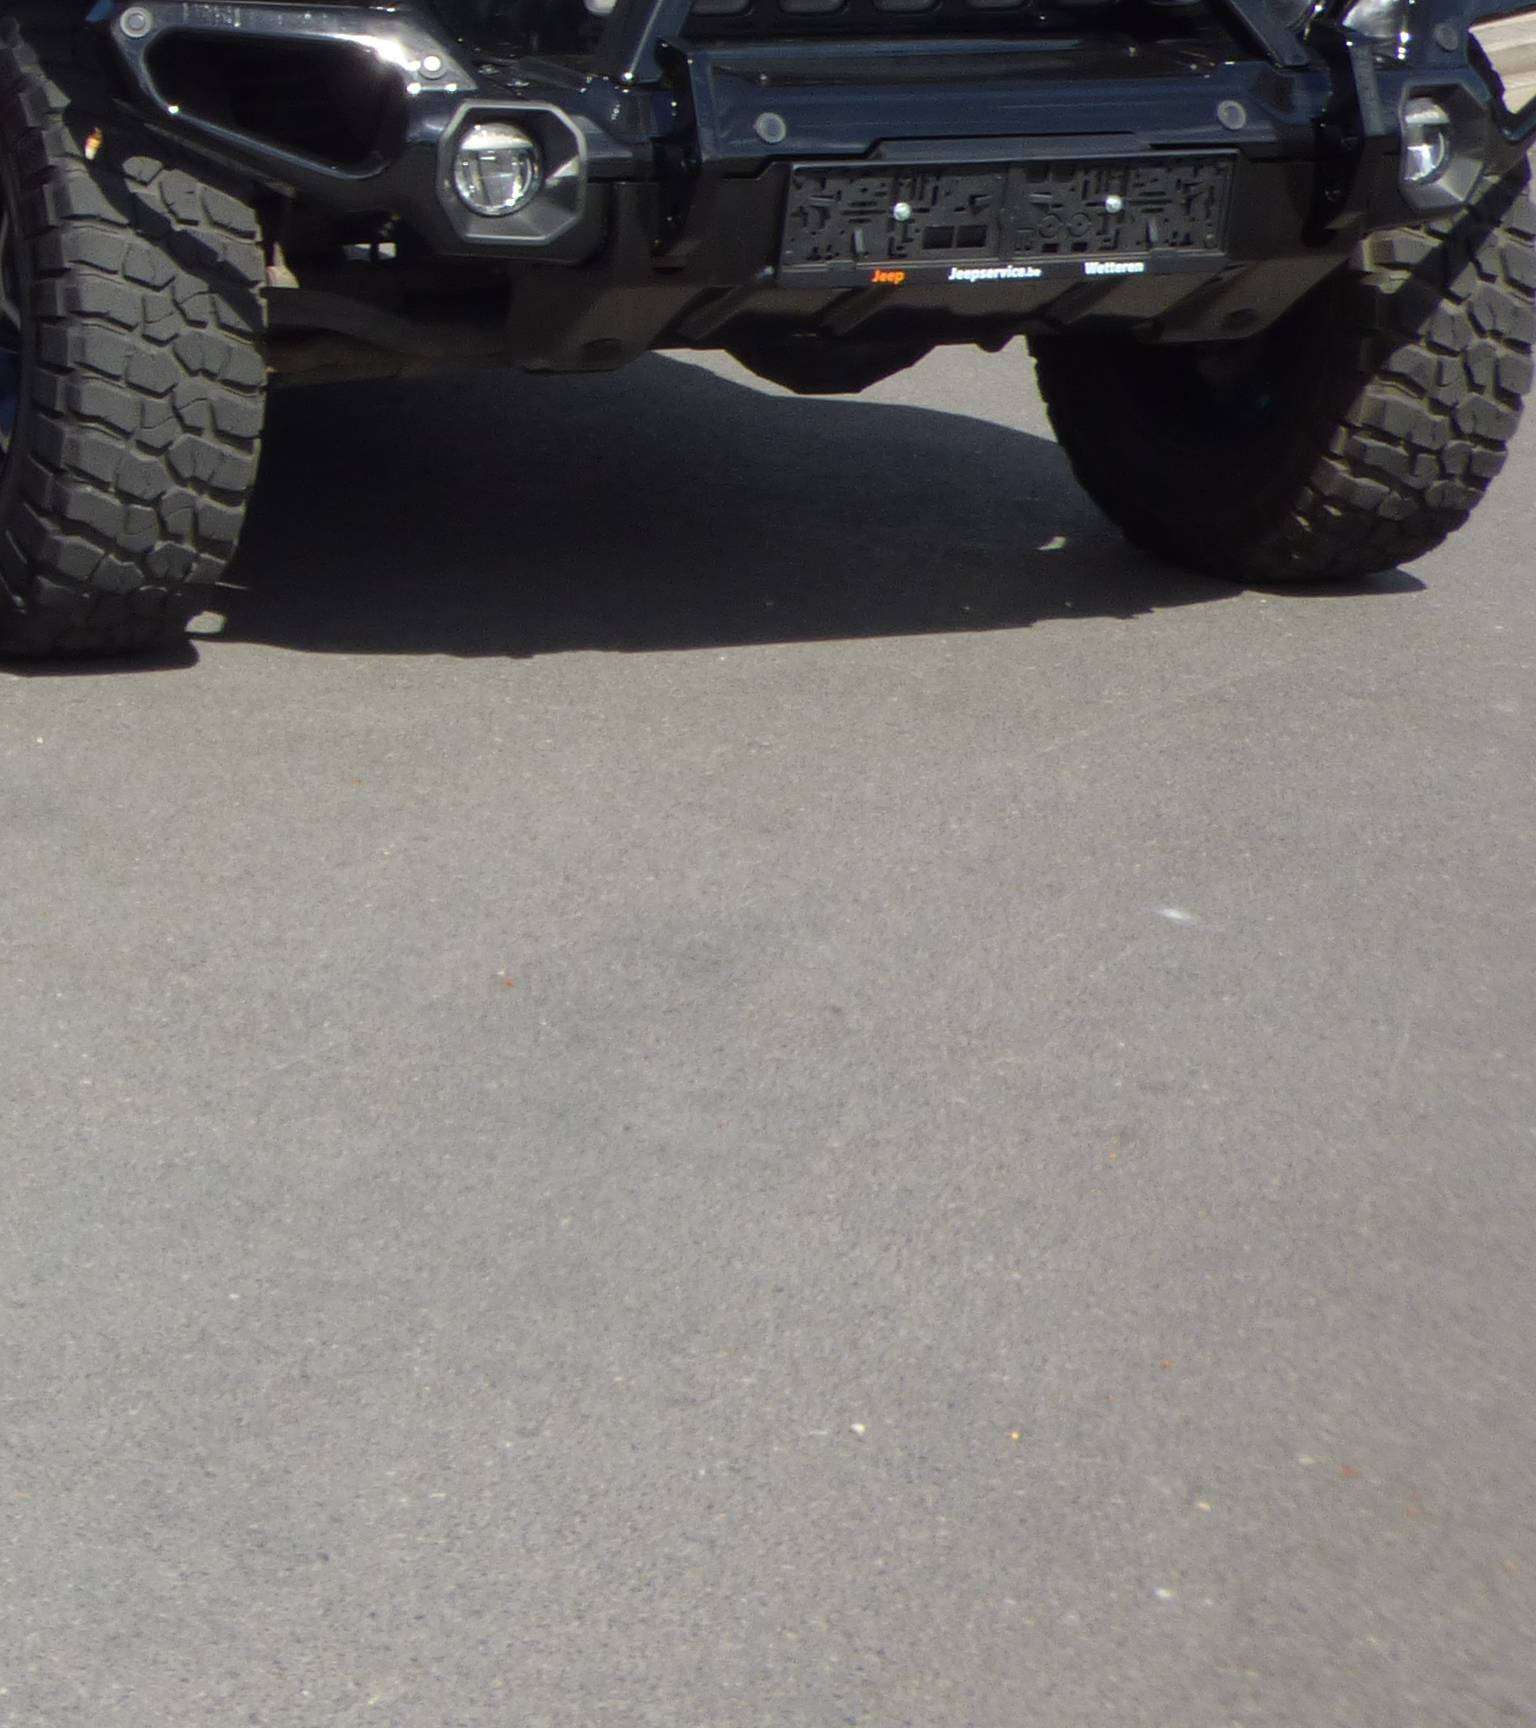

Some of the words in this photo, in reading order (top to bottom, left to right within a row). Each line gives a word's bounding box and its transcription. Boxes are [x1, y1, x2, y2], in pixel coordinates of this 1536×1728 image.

[872, 266, 905, 284] Jeep
[948, 265, 1042, 283] Jeepservice.be
[1083, 261, 1145, 275] Wetteren
